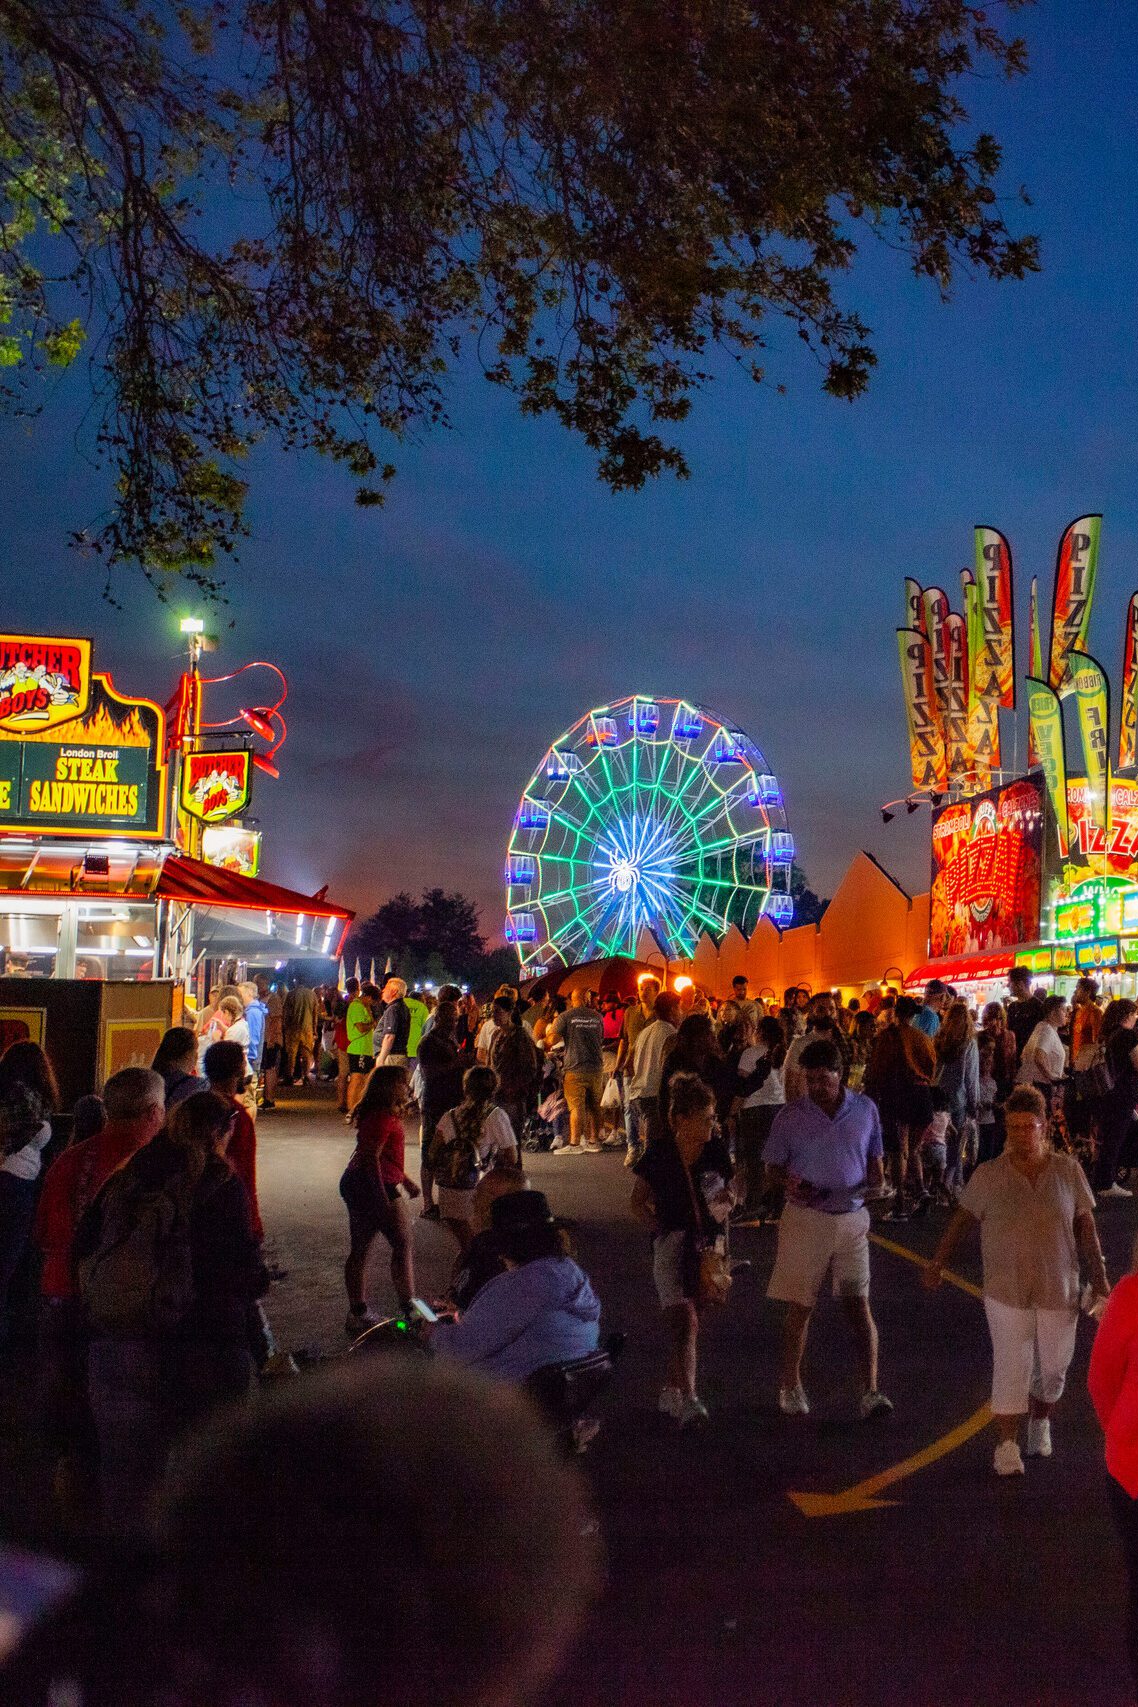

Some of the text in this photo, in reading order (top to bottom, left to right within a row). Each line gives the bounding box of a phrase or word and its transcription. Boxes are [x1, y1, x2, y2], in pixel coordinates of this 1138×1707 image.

[0, 688, 49, 719] BOYS
[60, 748, 119, 759] London Broil
[56, 758, 119, 782] STEAK
[30, 780, 138, 816] SANDWICHES
